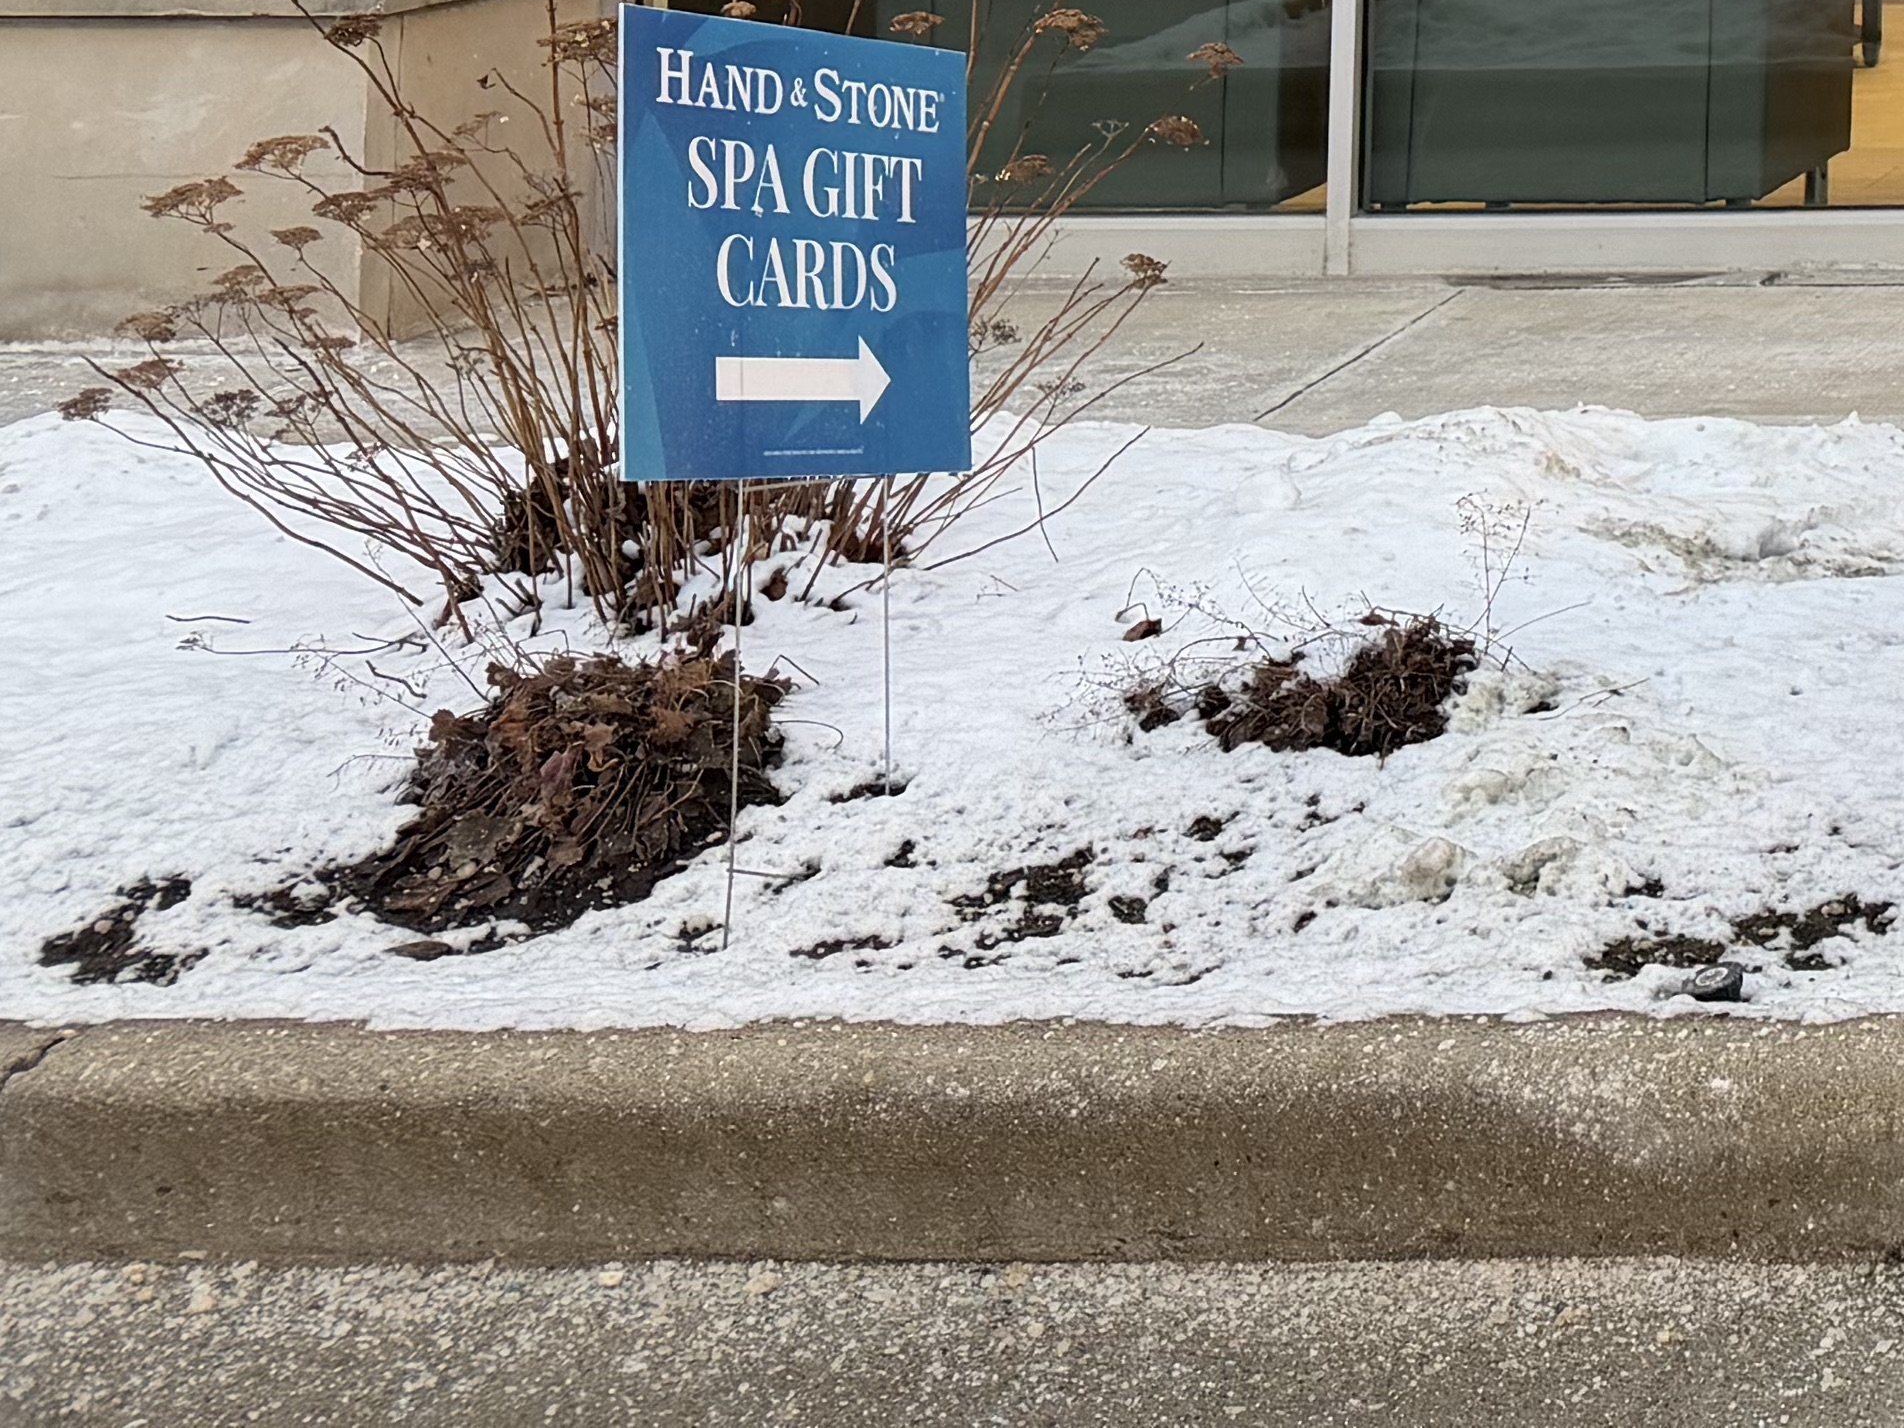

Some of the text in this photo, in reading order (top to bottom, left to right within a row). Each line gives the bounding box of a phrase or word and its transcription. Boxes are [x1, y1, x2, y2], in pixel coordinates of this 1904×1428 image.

[656, 46, 784, 115] HAND
[790, 76, 808, 109] &
[687, 135, 922, 224] SPA GIFT
[716, 233, 898, 313] CARDS
